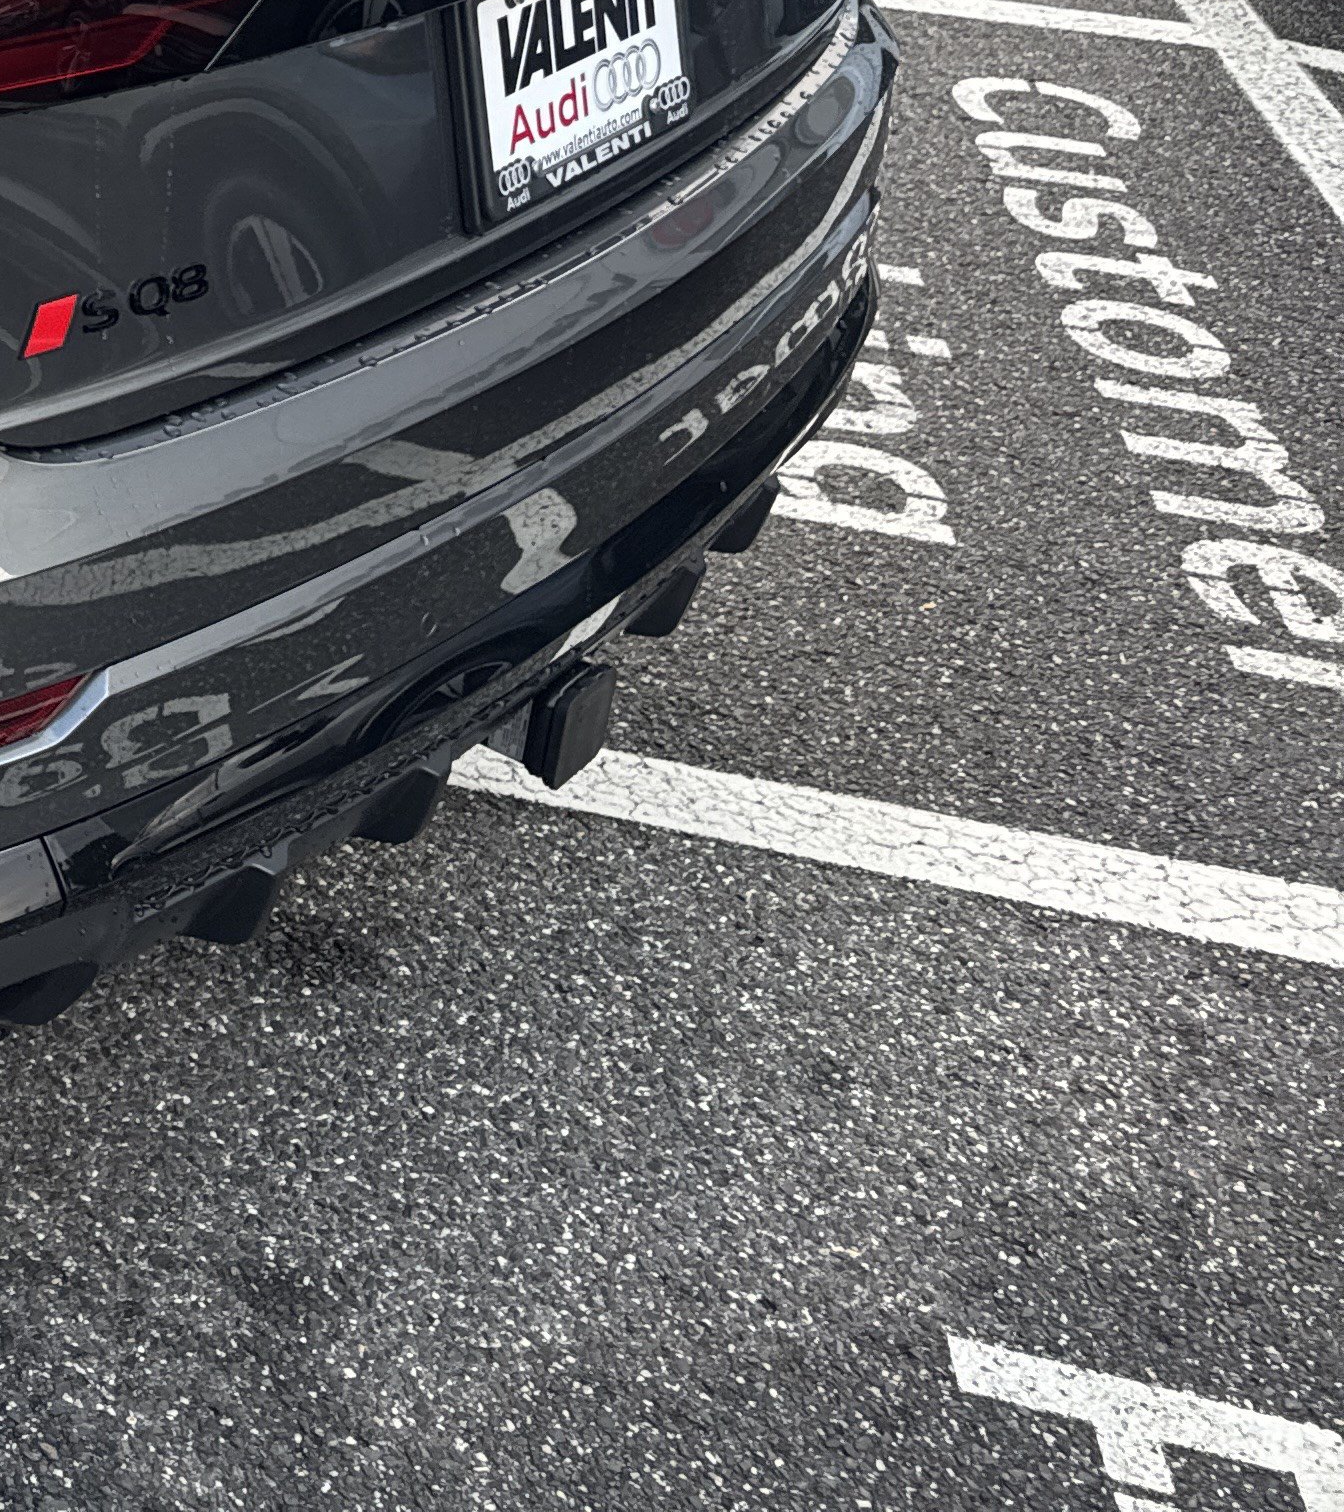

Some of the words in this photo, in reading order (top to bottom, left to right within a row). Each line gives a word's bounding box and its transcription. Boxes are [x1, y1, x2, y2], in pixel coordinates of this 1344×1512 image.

[510, 72, 589, 156] Audi
[666, 102, 690, 125] Audi
[545, 120, 653, 188] VALENTI
[506, 187, 532, 213] Audi
